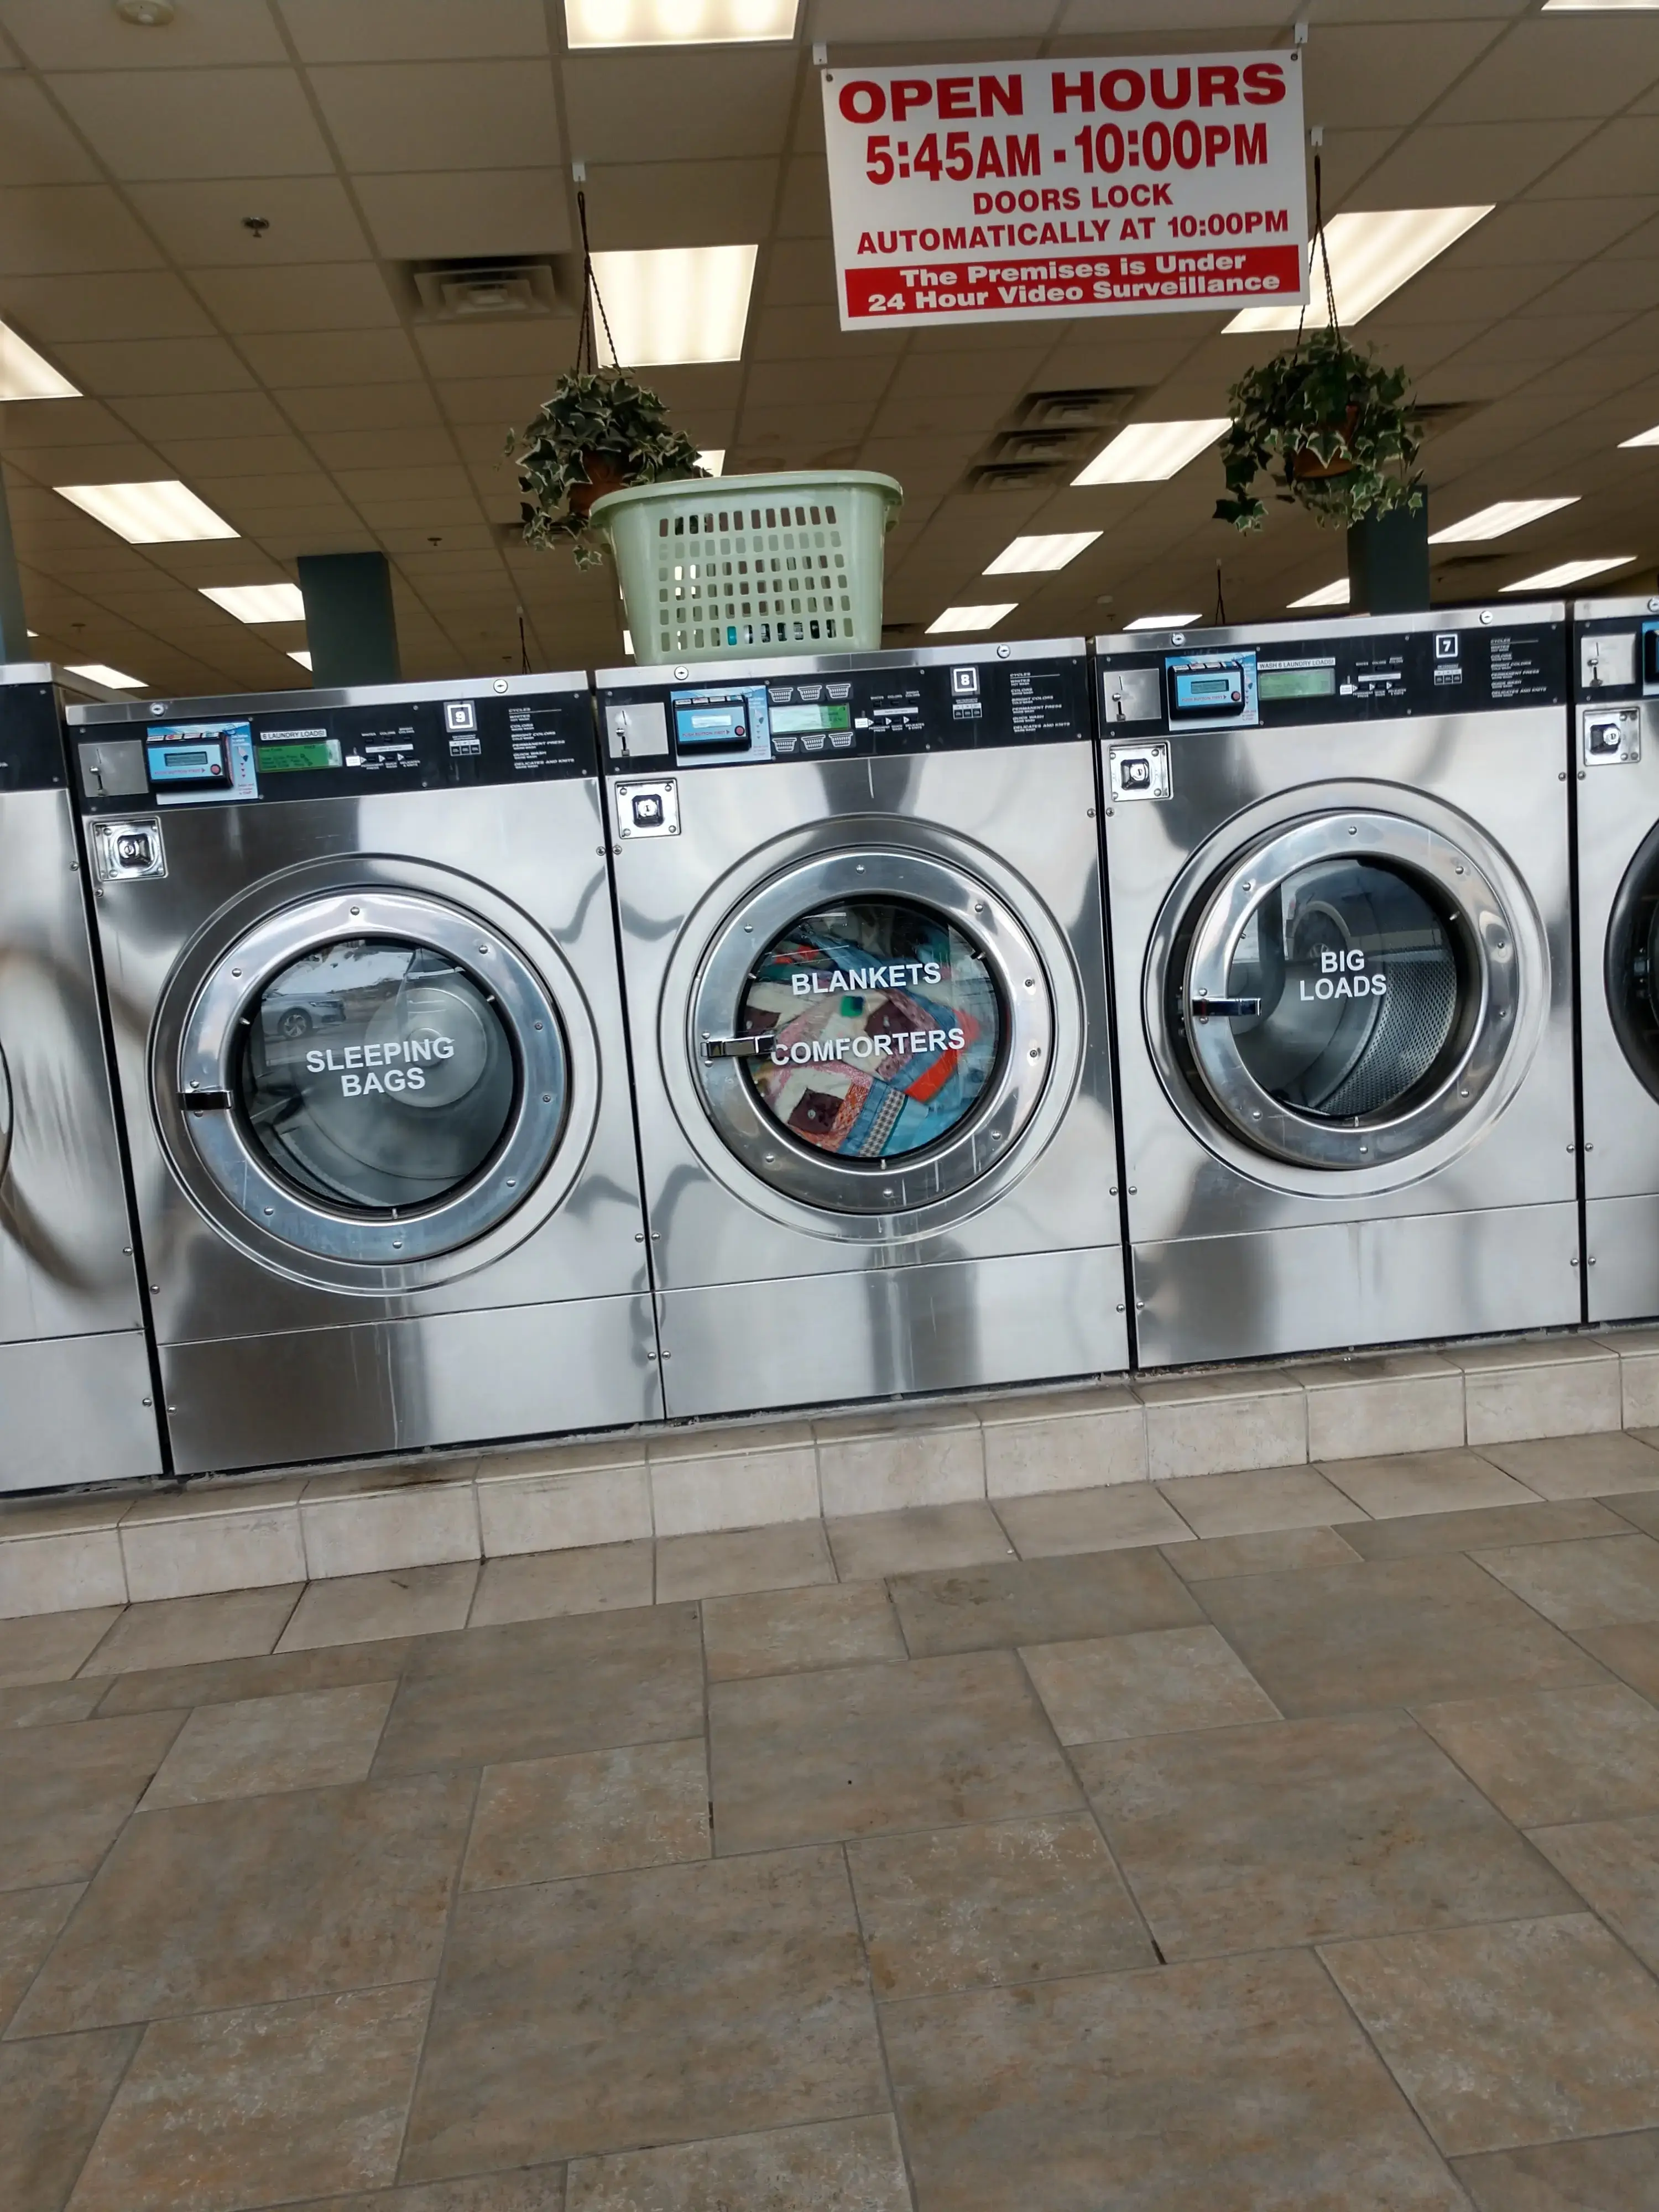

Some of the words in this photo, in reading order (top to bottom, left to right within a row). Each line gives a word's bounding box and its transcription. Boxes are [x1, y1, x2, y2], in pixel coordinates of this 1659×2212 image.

[839, 75, 1024, 124] OPEN
[1052, 62, 1286, 113] HOURS
[866, 132, 1041, 185] 5:45AM
[1075, 119, 1268, 174] 10:00PM
[973, 186, 1081, 215] DOORS
[1092, 183, 1173, 209] LOCK
[857, 220, 1110, 254] AUTOMATICALLY
[1120, 217, 1156, 240] AT
[1167, 210, 1288, 237] 10:00PM
[900, 268, 958, 287] The
[968, 260, 1110, 284] Premises
[1120, 258, 1146, 276] is
[1155, 254, 1246, 274] Under
[868, 294, 905, 312] 24
[915, 288, 990, 309] Hour
[997, 284, 1083, 303] Video
[1093, 273, 1280, 299] Surveillance
[1443, 640, 1451, 652] 7
[961, 674, 970, 686] 8
[455, 711, 466, 723] 9
[1321, 950, 1365, 973] BIG
[791, 962, 941, 995] BLANKETS
[1300, 974, 1387, 1001] LOADS
[306, 1037, 455, 1073] SLEEPING
[770, 1028, 966, 1066] COMFORTERS
[341, 1067, 426, 1097] BAGS
